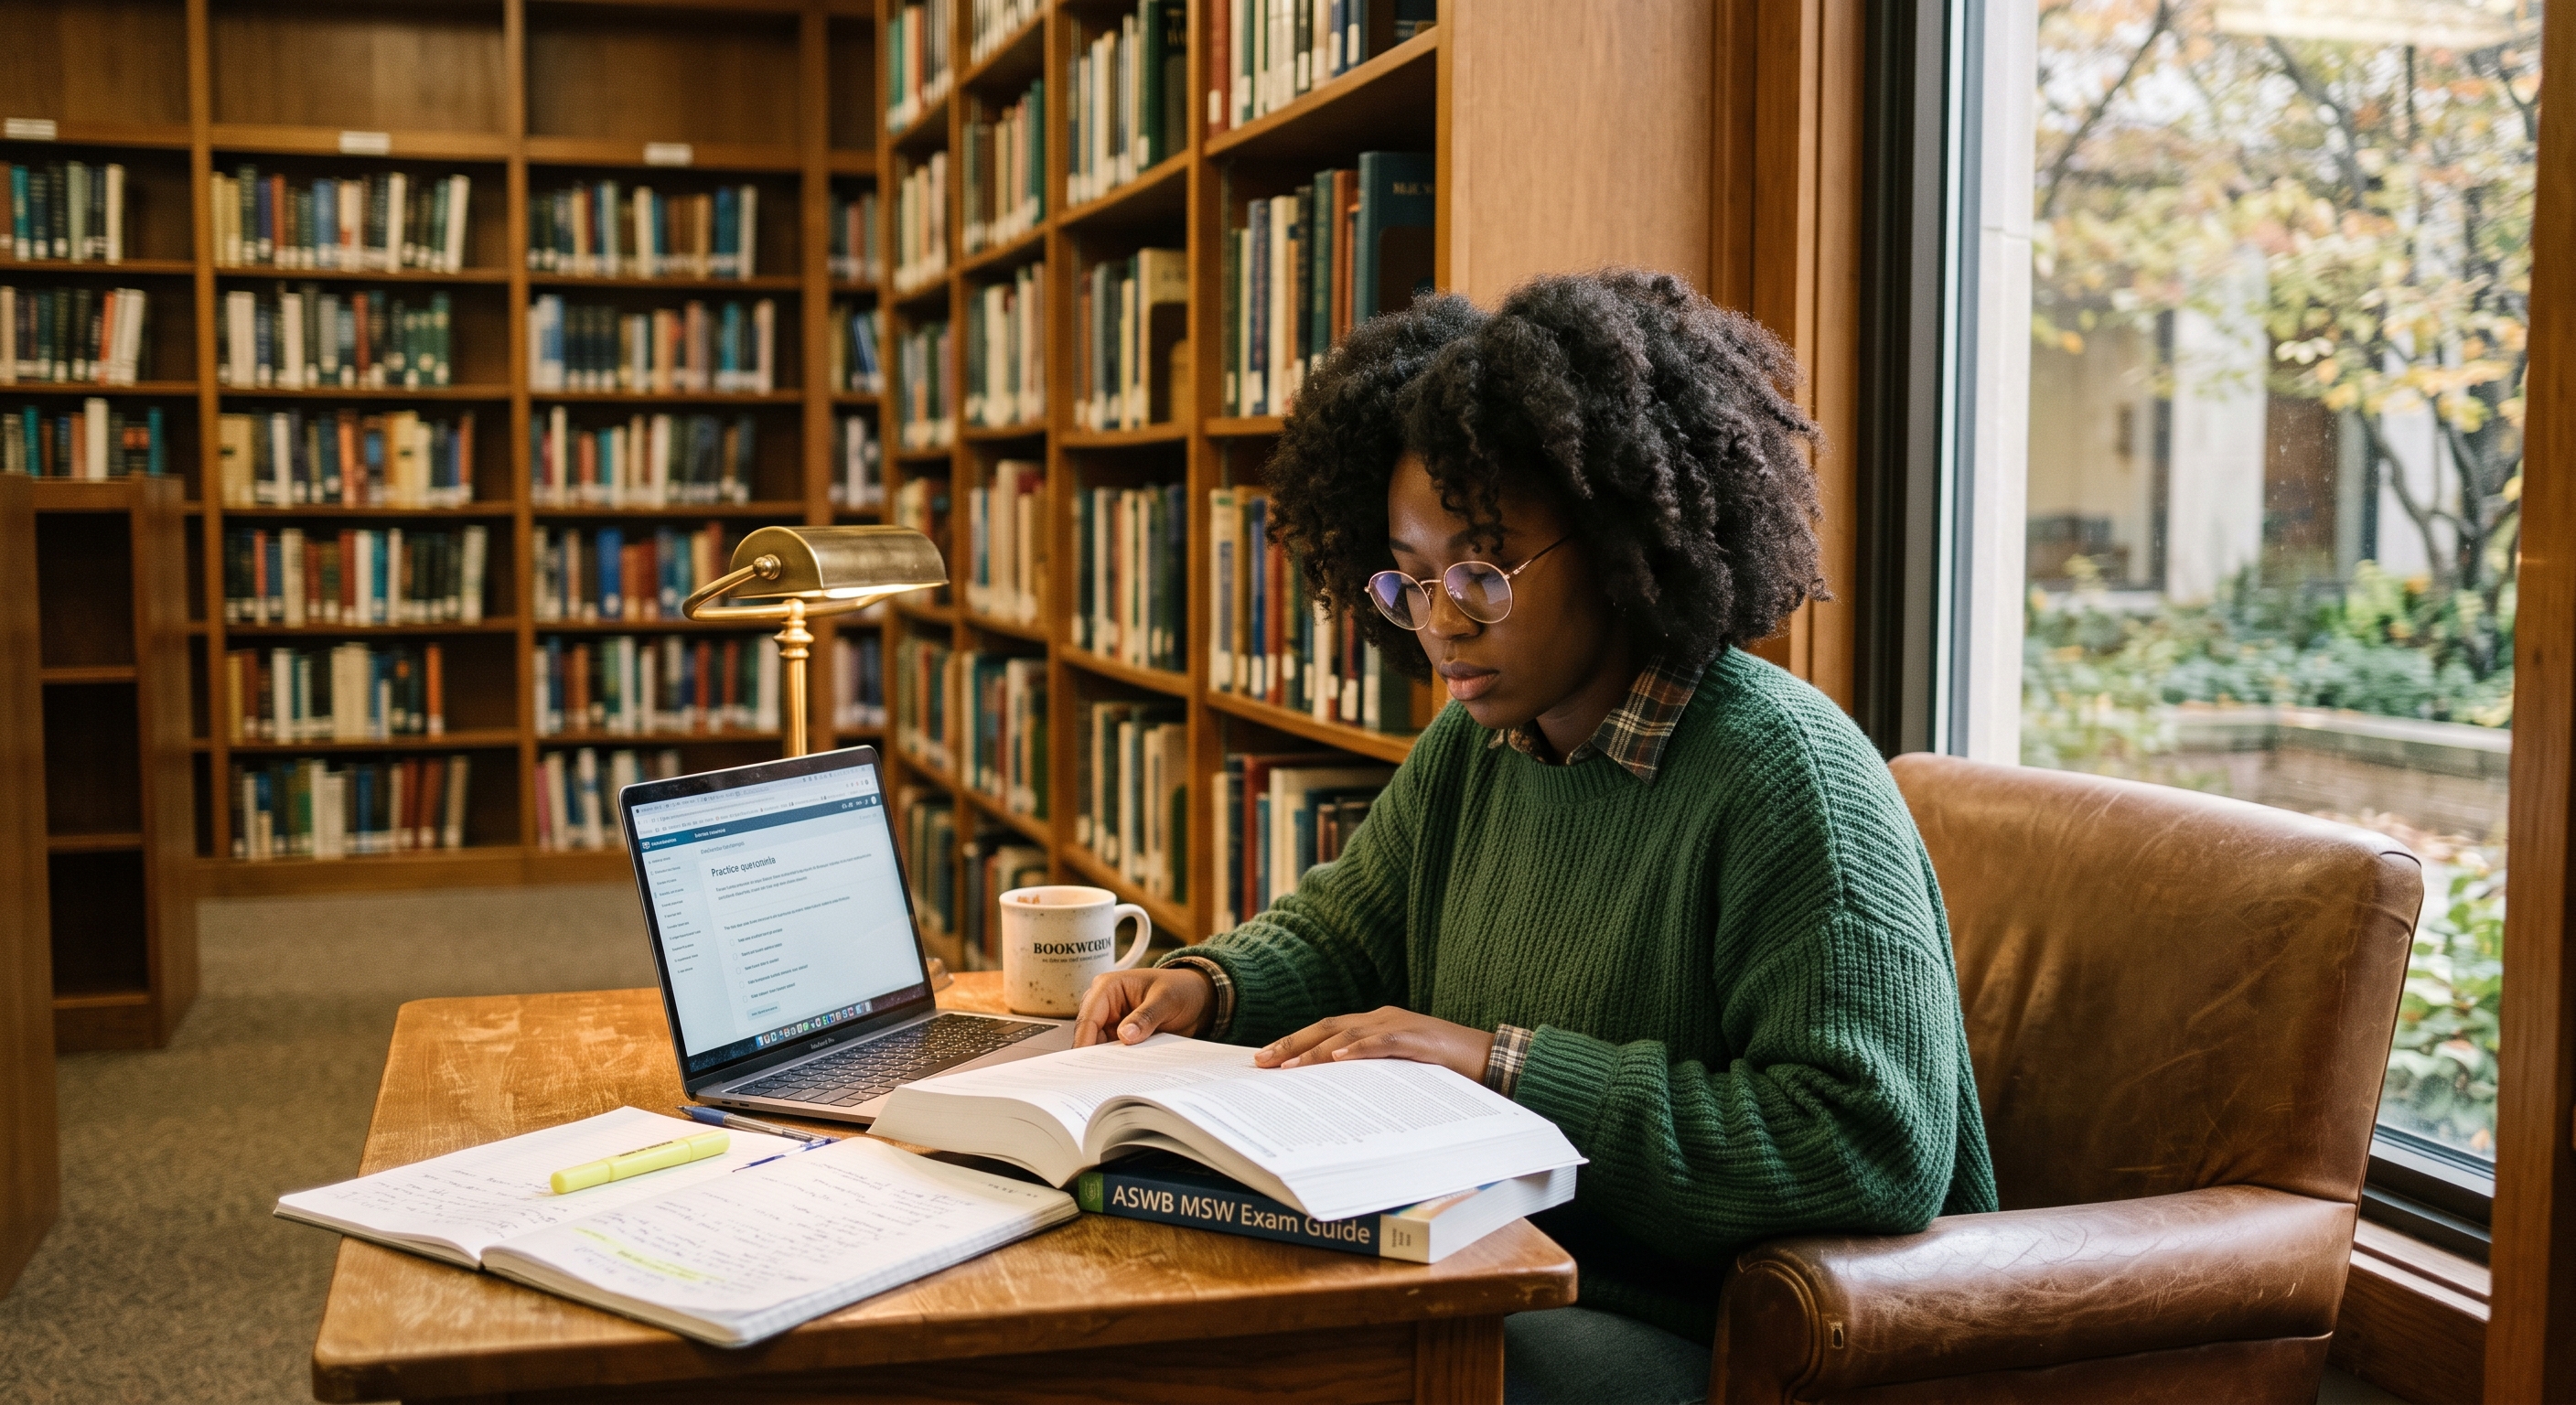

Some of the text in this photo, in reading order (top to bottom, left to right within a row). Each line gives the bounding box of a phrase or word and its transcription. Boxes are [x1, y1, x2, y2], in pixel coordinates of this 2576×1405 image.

[711, 864, 739, 877] Practice
[1111, 1185, 1175, 1214] ASWB
[1180, 1195, 1236, 1223] MSW
[1240, 1203, 1299, 1234] Exam
[1304, 1215, 1371, 1245] Guide
